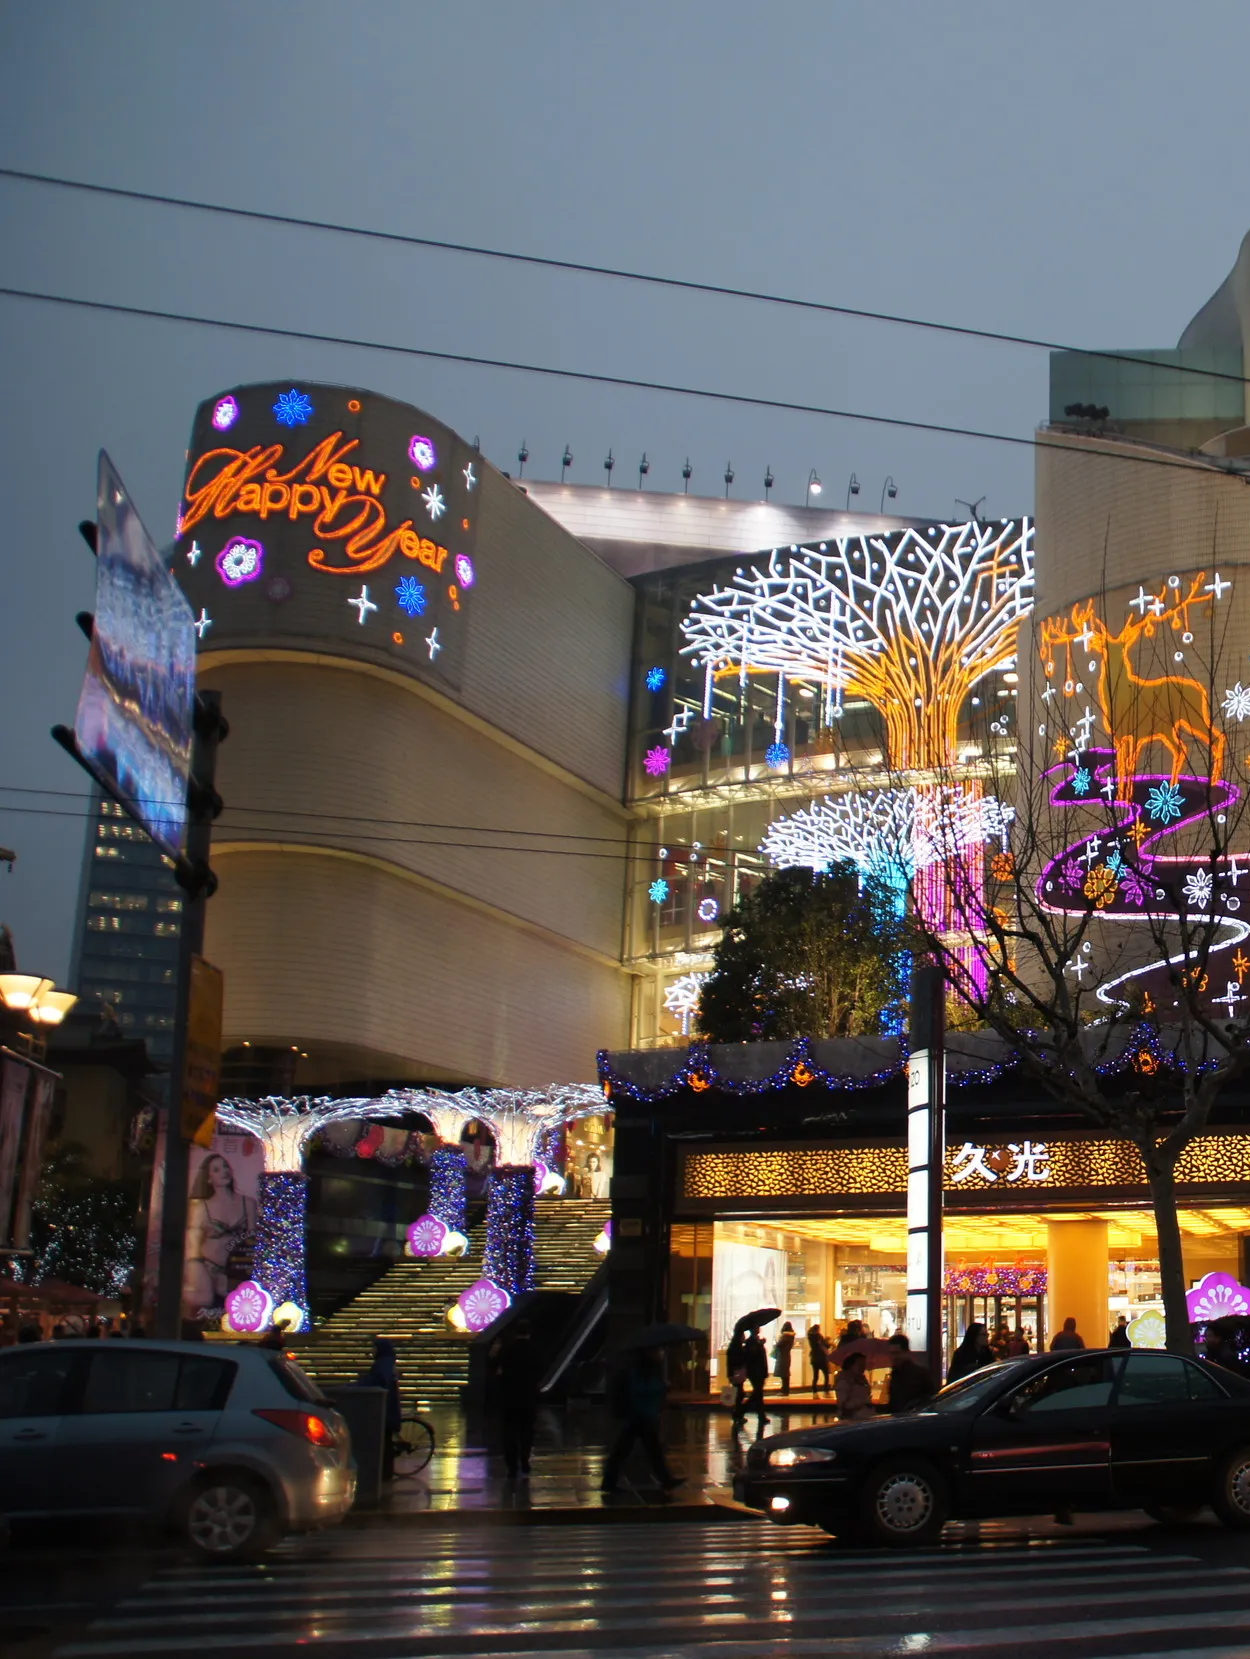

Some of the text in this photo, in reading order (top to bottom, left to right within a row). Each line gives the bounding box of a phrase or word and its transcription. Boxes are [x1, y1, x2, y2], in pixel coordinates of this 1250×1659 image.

[179, 444, 348, 534] Happy
[265, 431, 386, 496] New
[308, 494, 449, 575] Year
[951, 1140, 1050, 1182] 久光
